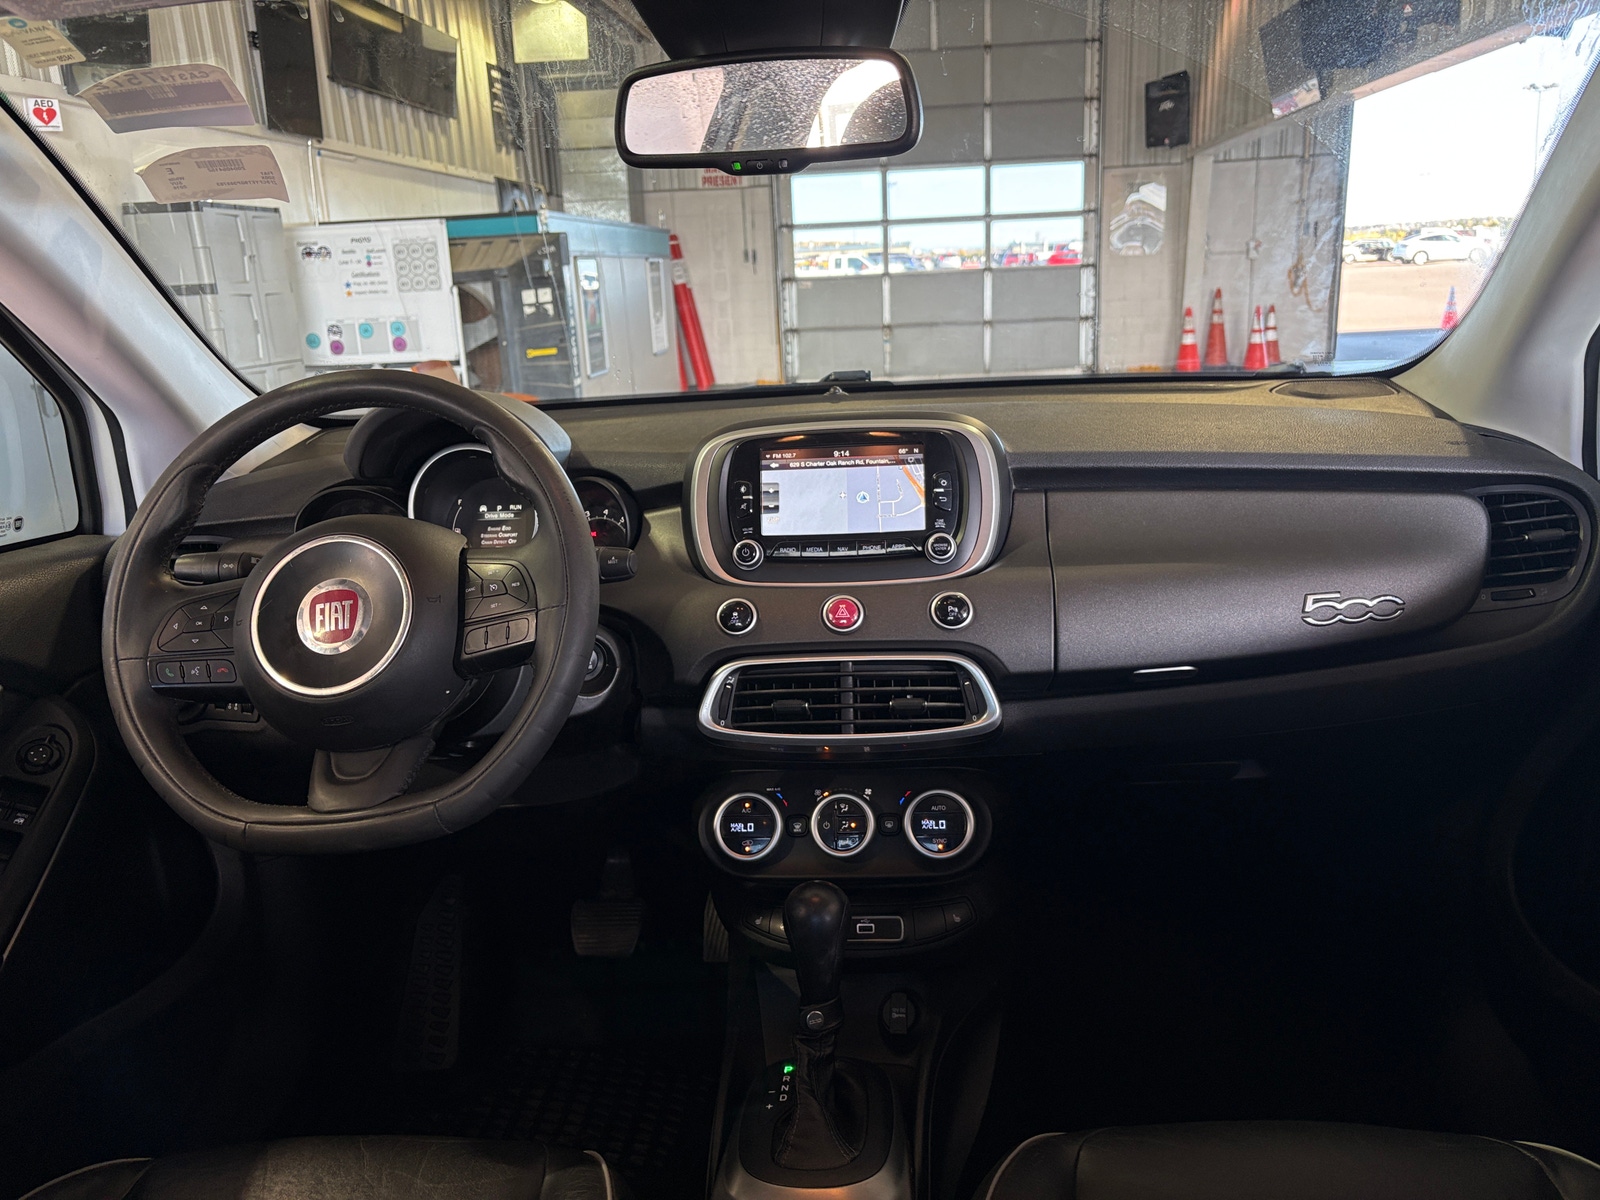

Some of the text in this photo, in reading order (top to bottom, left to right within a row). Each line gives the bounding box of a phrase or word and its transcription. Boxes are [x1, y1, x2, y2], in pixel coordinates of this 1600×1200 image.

[33, 99, 54, 108] AED
[833, 450, 850, 458] 9:14
[1301, 591, 1406, 627] 500
[315, 600, 354, 634] FIAT
[742, 822, 754, 832] LO
[933, 820, 946, 829] LO
[784, 1065, 793, 1074] P
